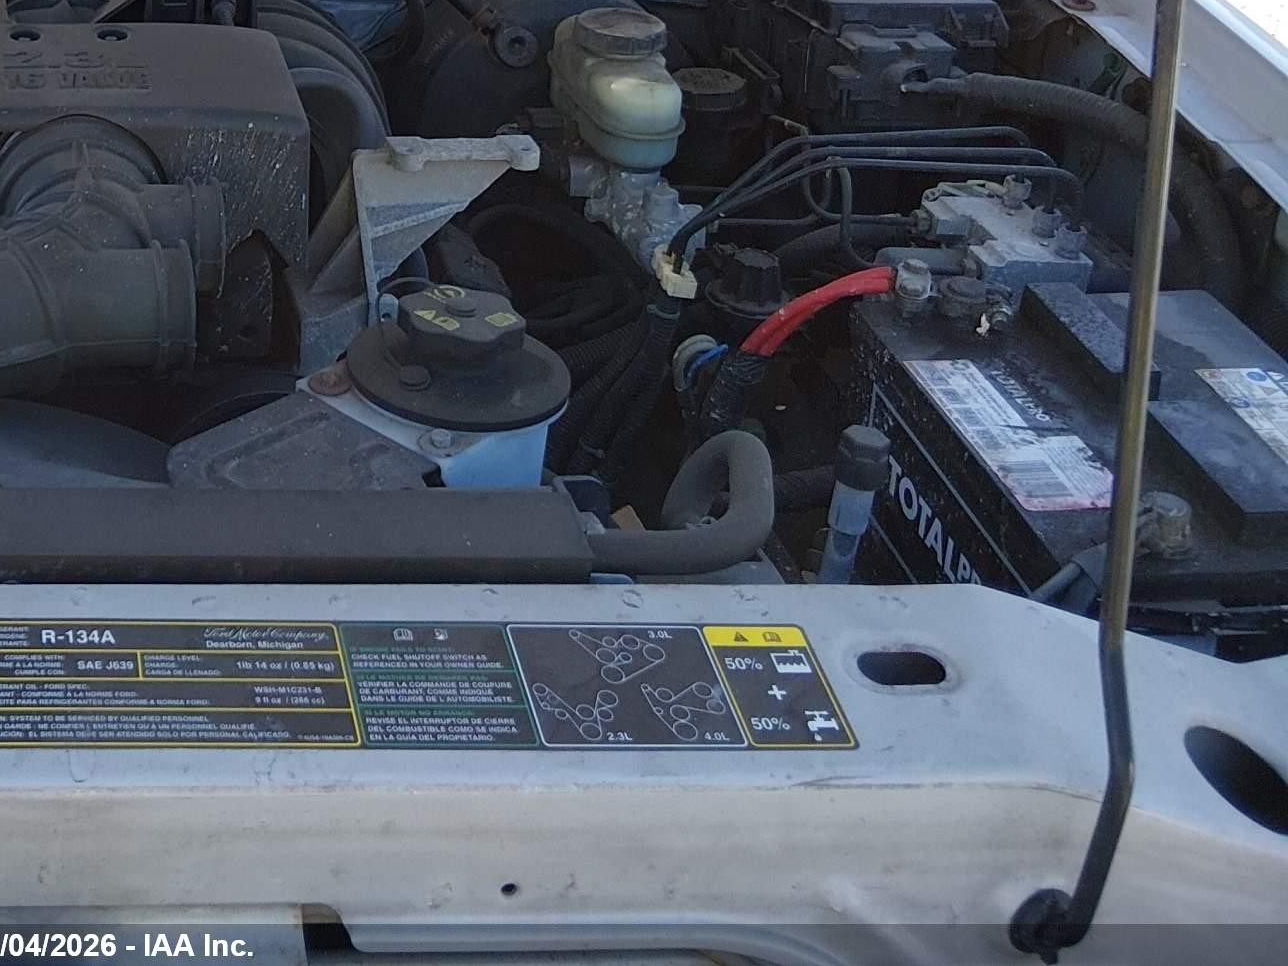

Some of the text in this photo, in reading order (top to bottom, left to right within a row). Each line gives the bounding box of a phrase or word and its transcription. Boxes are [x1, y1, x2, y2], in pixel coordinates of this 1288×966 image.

[56, 72, 152, 91] VALVE
[41, 629, 115, 644] R-134A
[647, 630, 672, 639] 3.0L
[205, 641, 304, 650] Dearborn, Michigan
[77, 660, 134, 670] SAE J639
[254, 661, 268, 670] 14
[318, 662, 335, 672] kg)
[725, 657, 763, 671] 50%
[751, 717, 791, 731] 50%
[606, 732, 633, 742] 2.3L
[704, 731, 730, 741] 4.0L
